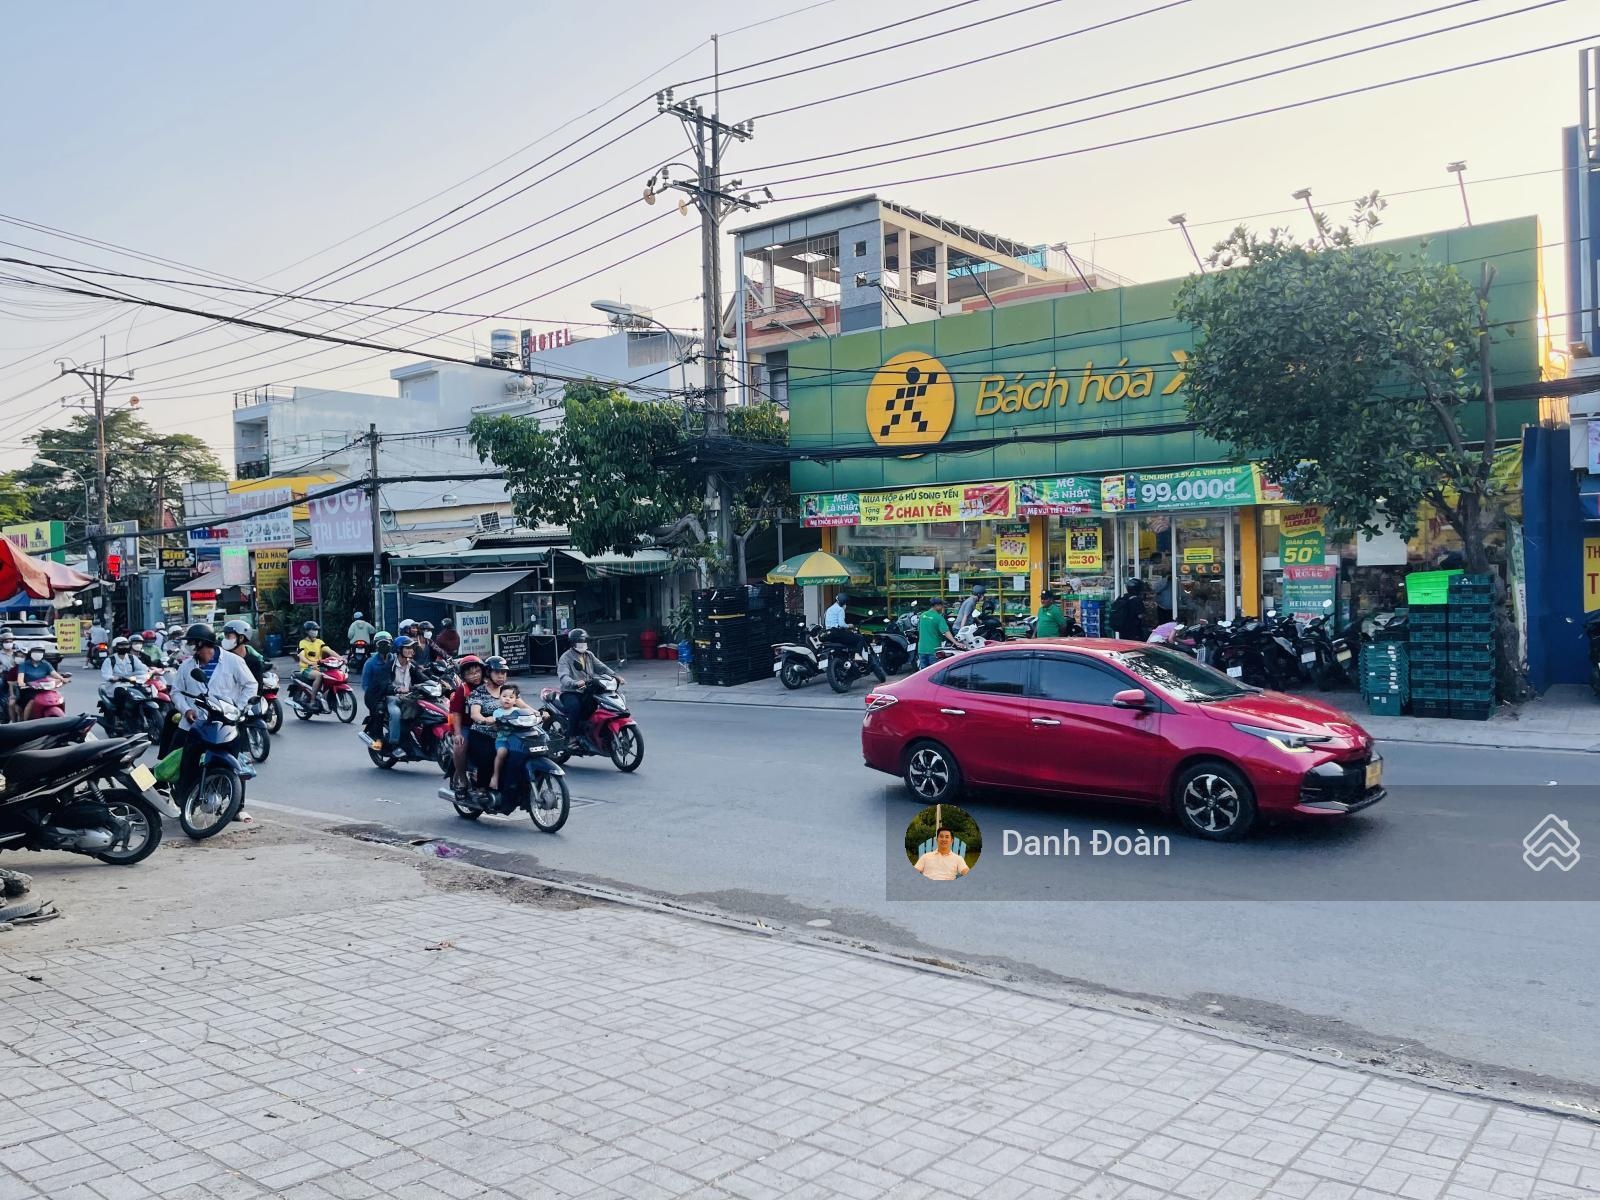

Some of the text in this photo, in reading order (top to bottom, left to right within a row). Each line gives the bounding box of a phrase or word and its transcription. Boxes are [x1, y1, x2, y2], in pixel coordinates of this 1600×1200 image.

[528, 328, 571, 353] HOTEL
[975, 366, 1069, 417] Bách
[1077, 357, 1156, 404] hóa
[863, 495, 880, 503] MUA
[918, 491, 941, 500] SONG
[1141, 478, 1236, 503] 99.000đ
[884, 504, 894, 520] 2
[896, 506, 924, 518] CHAI
[294, 579, 318, 587] YOGA
